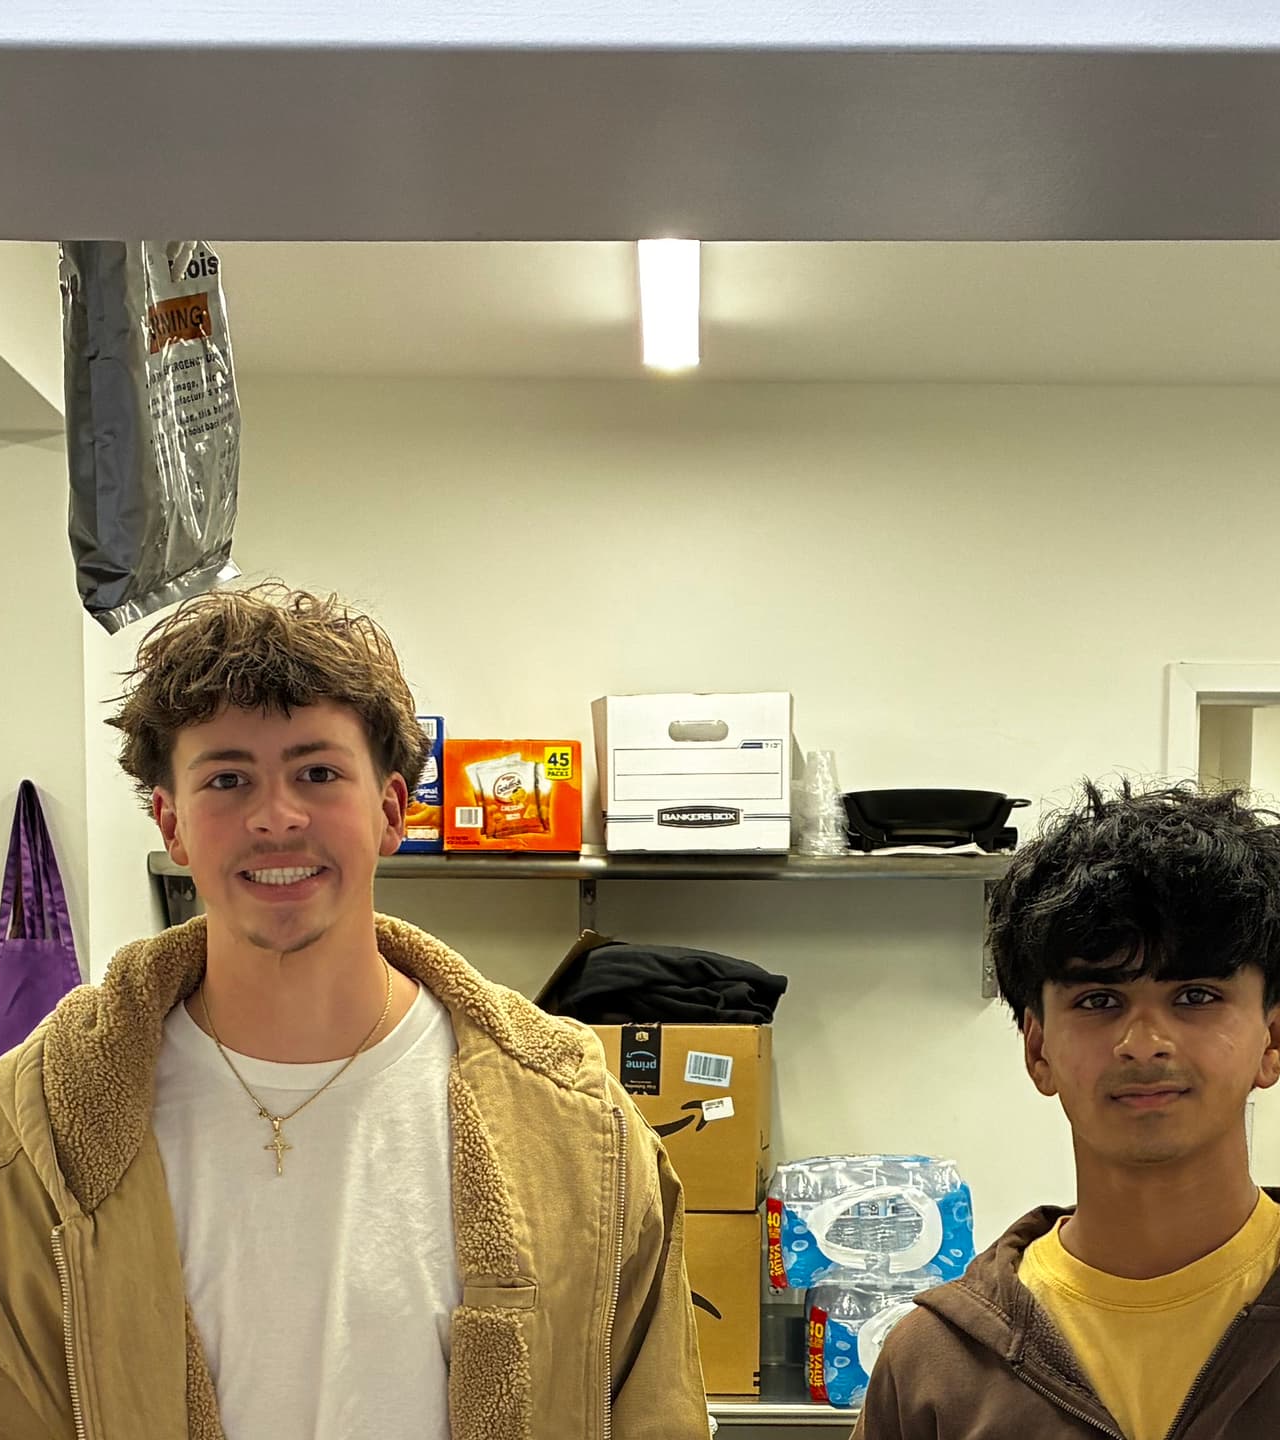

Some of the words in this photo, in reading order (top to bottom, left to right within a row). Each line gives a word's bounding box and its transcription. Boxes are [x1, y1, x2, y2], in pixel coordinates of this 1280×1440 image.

[547, 752, 570, 767] 45
[661, 812, 712, 822] BANKERS
[713, 812, 736, 821] BOX
[626, 1059, 657, 1071] prime
[774, 1244, 785, 1276] VALUE
[814, 1353, 825, 1387] VALUE
